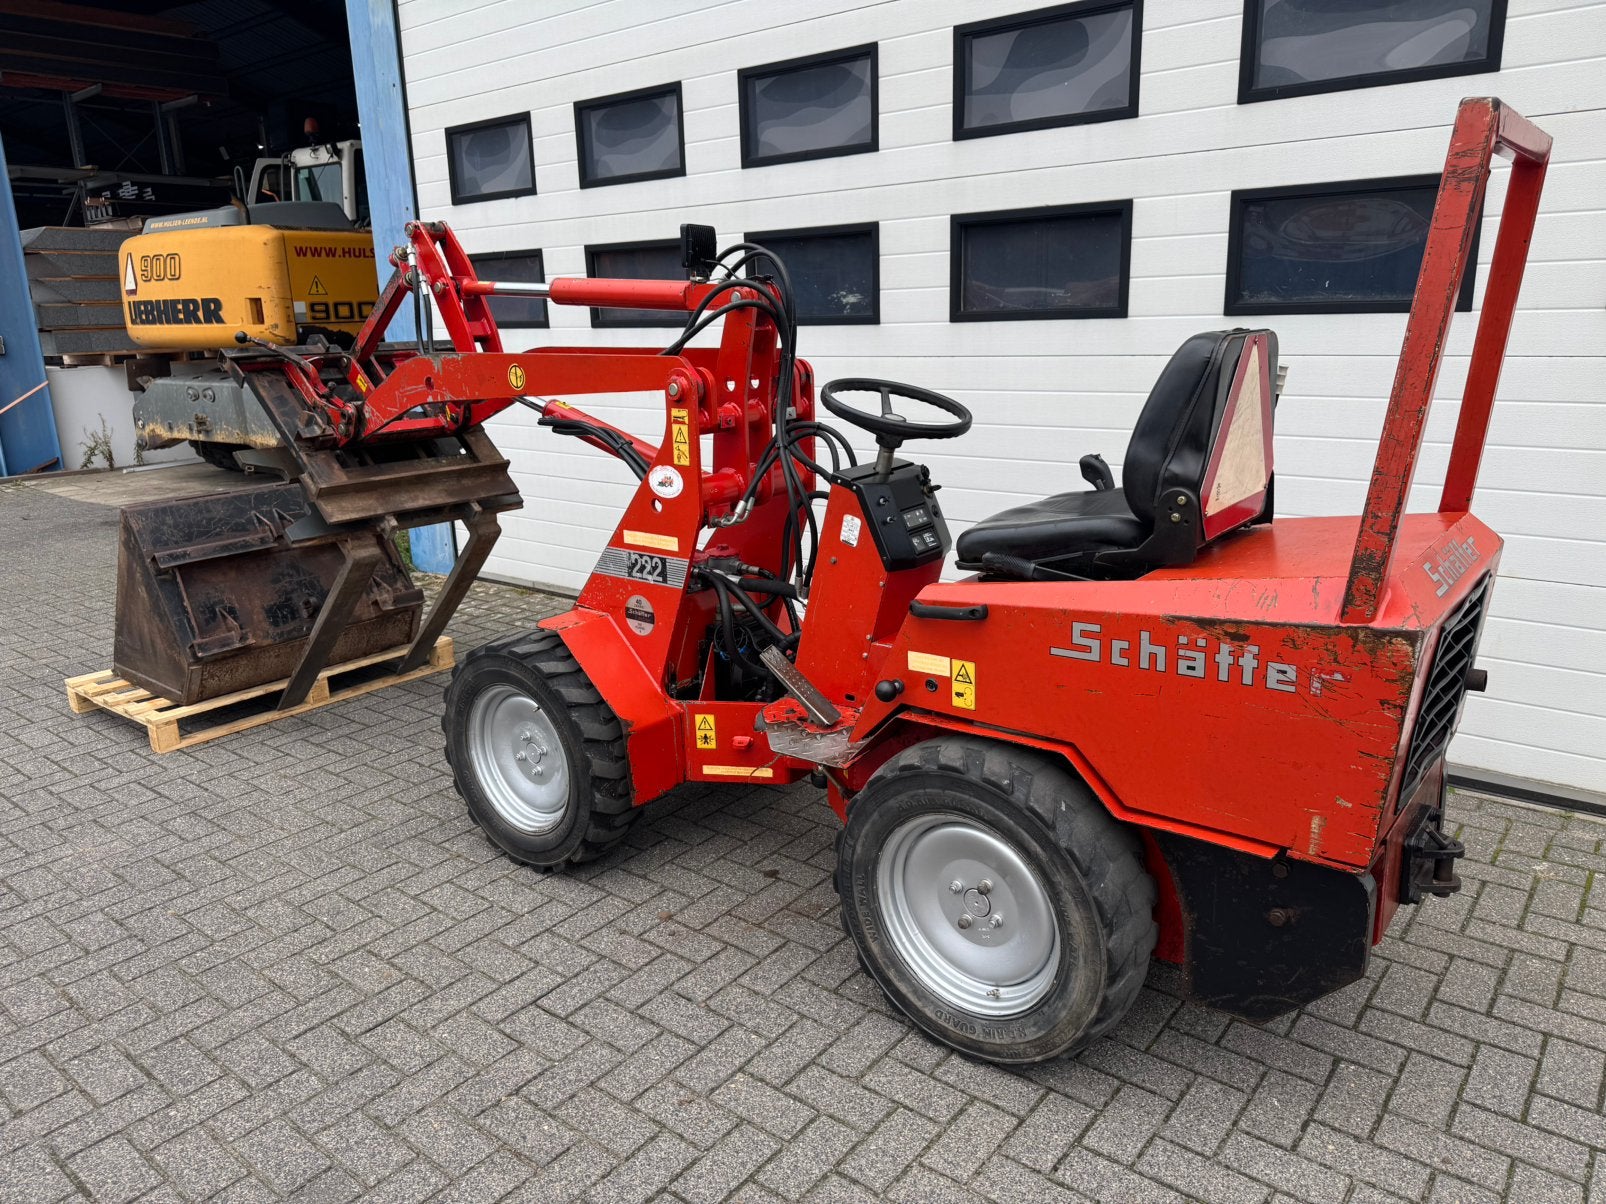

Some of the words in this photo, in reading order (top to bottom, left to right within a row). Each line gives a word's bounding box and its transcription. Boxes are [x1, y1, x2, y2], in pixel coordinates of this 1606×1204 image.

[140, 252, 181, 282] 900
[127, 297, 226, 326] LIEBHERR
[310, 301, 376, 321] 900
[630, 551, 663, 582] 222
[1423, 536, 1481, 598] Schäffer
[1050, 621, 1352, 698] Schäffer
